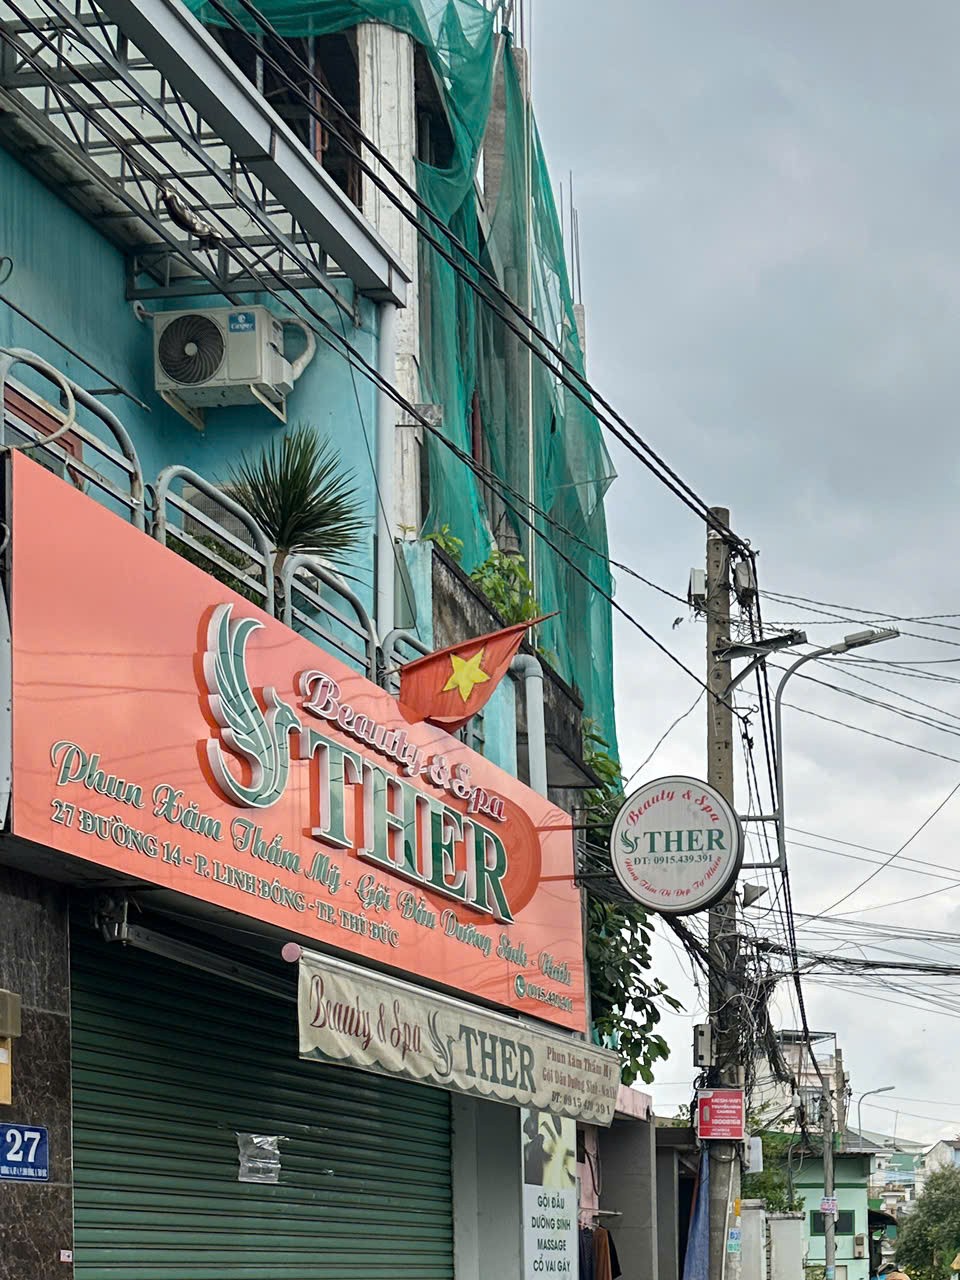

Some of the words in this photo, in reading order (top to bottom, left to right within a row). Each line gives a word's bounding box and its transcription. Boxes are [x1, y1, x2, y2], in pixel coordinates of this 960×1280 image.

[299, 669, 428, 778] Beauty
[425, 753, 452, 789] &
[449, 761, 508, 823] Spa
[625, 789, 675, 827] Beauty
[682, 789, 692, 800] &
[694, 794, 720, 823] Spa
[51, 740, 145, 809] Phun
[152, 783, 225, 842] Xăm
[231, 815, 302, 875] Thẩm
[355, 873, 393, 913] Gội
[51, 798, 75, 828] 27
[78, 807, 160, 859] ĐƯỜNG
[162, 841, 183, 867] 14
[194, 851, 211, 878] P.
[212, 860, 258, 895] LINH
[257, 877, 306, 913] ĐÔNG
[315, 898, 337, 926] TP.
[338, 909, 369, 936] THỦ
[369, 920, 400, 948] ĐỨC
[653, 854, 713, 865] 0915.439.391
[309, 974, 373, 1051] Beauty
[377, 1002, 387, 1045] &
[390, 999, 422, 1062] Spa
[546, 1046, 566, 1065] Phun
[6, 1129, 41, 1163] 27
[556, 1218, 571, 1231] SINH
[537, 1238, 567, 1252] MASSAGE
[533, 1253, 544, 1272] CỔ
[545, 1260, 556, 1273] VAI
